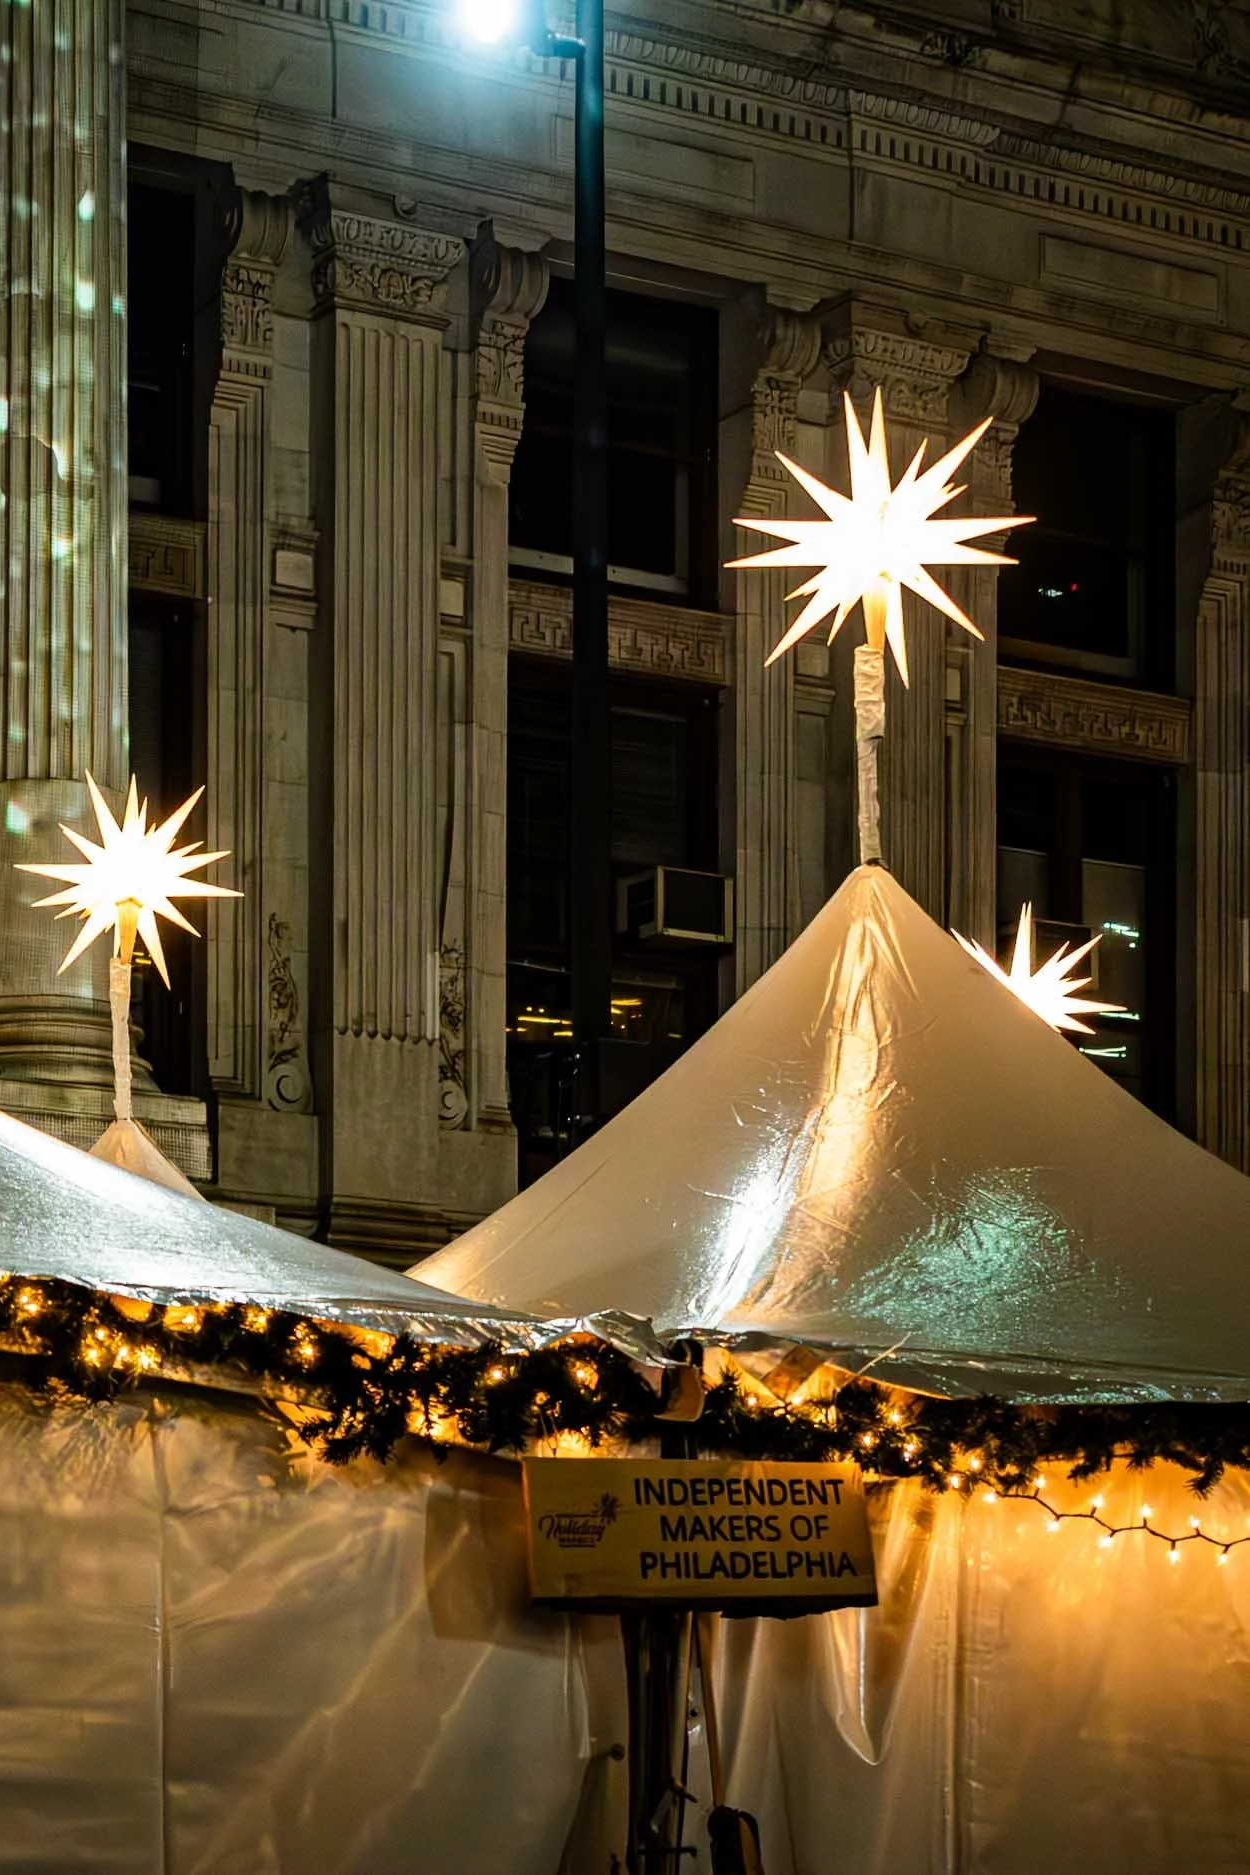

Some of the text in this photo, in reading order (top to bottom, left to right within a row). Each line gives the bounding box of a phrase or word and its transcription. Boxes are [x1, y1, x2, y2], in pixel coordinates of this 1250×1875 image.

[634, 1478, 844, 1506] INDEPENDENT
[660, 1514, 829, 1542] MAKERS OF
[640, 1550, 857, 1580] PHILADELPHIA
